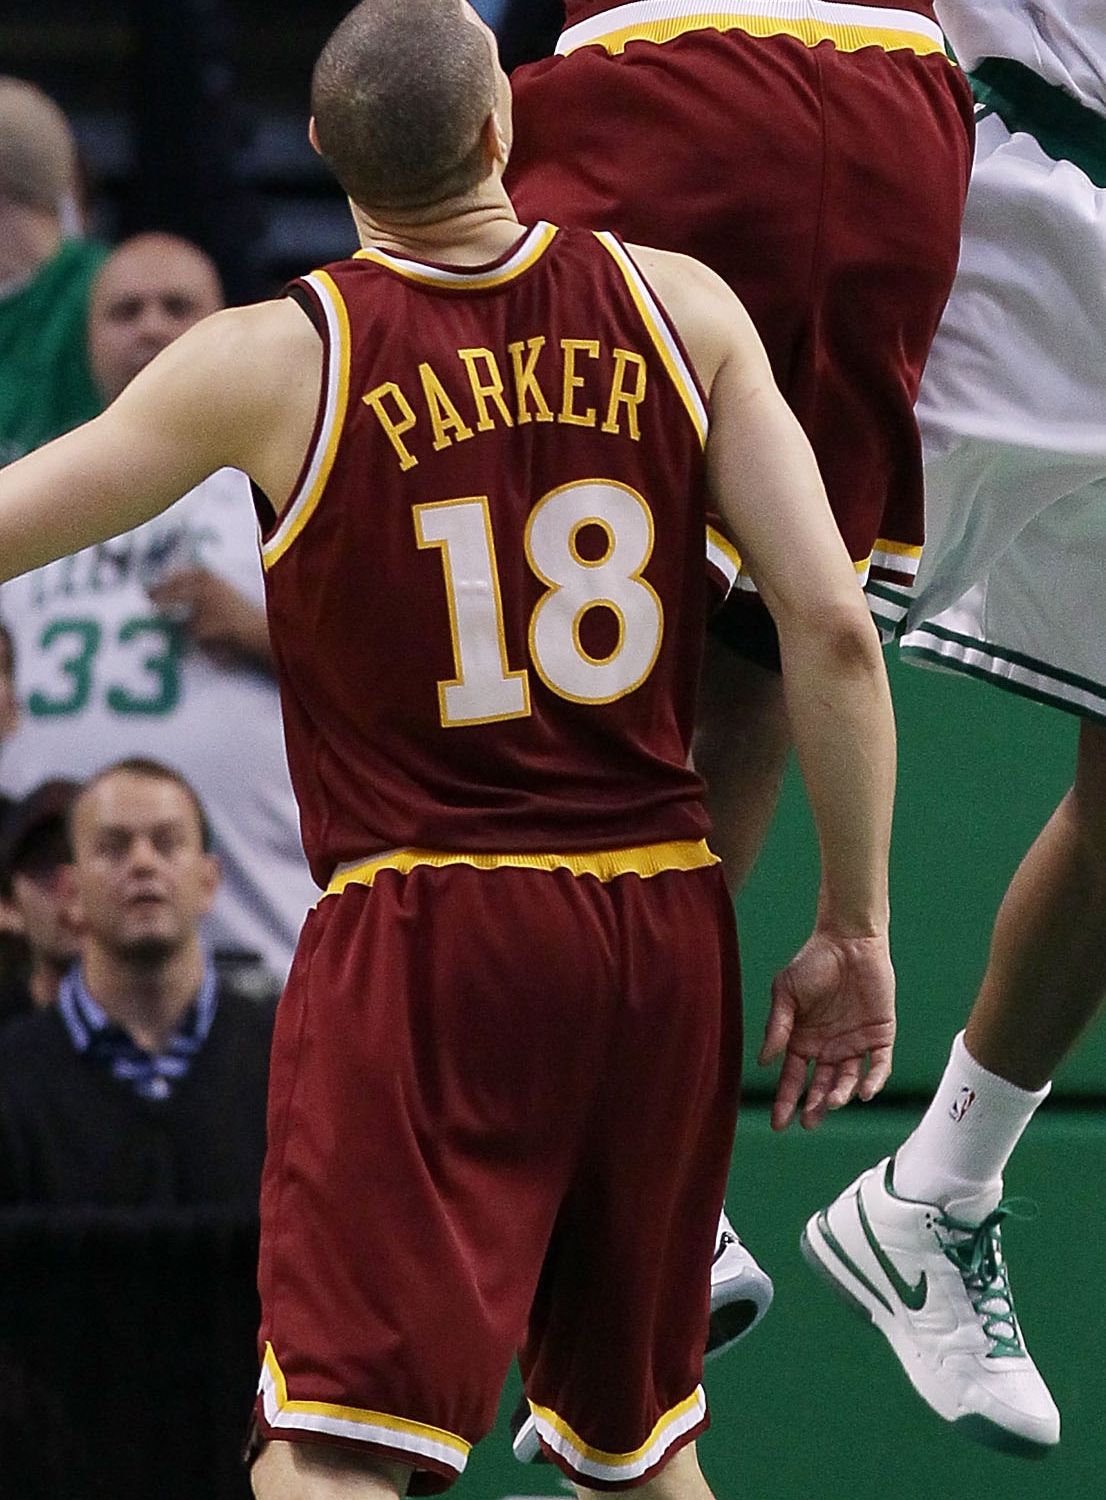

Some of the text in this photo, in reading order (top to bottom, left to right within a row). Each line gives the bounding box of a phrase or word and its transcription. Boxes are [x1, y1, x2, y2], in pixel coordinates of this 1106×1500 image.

[362, 336, 647, 472] PARKER
[28, 614, 187, 717] 33
[412, 478, 664, 728] 18
